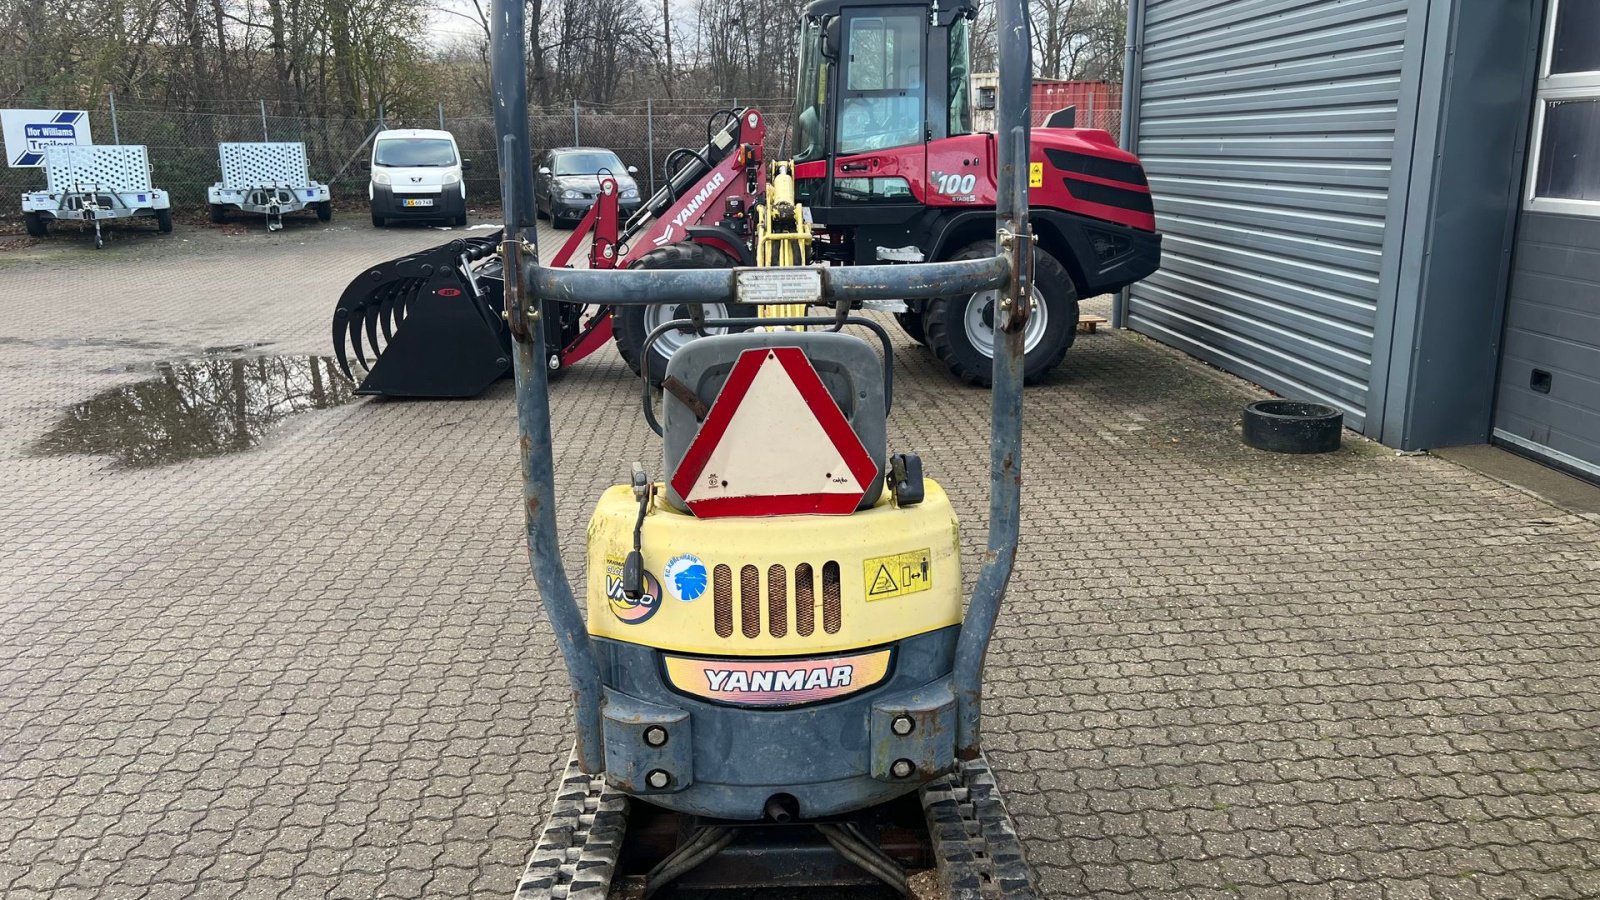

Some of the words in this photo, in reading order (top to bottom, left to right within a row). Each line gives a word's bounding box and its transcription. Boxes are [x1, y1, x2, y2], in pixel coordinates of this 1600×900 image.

[27, 127, 41, 137] Ifor
[41, 127, 73, 137] Williams
[672, 172, 725, 227] YANMAR
[704, 665, 853, 692] YANMAR
